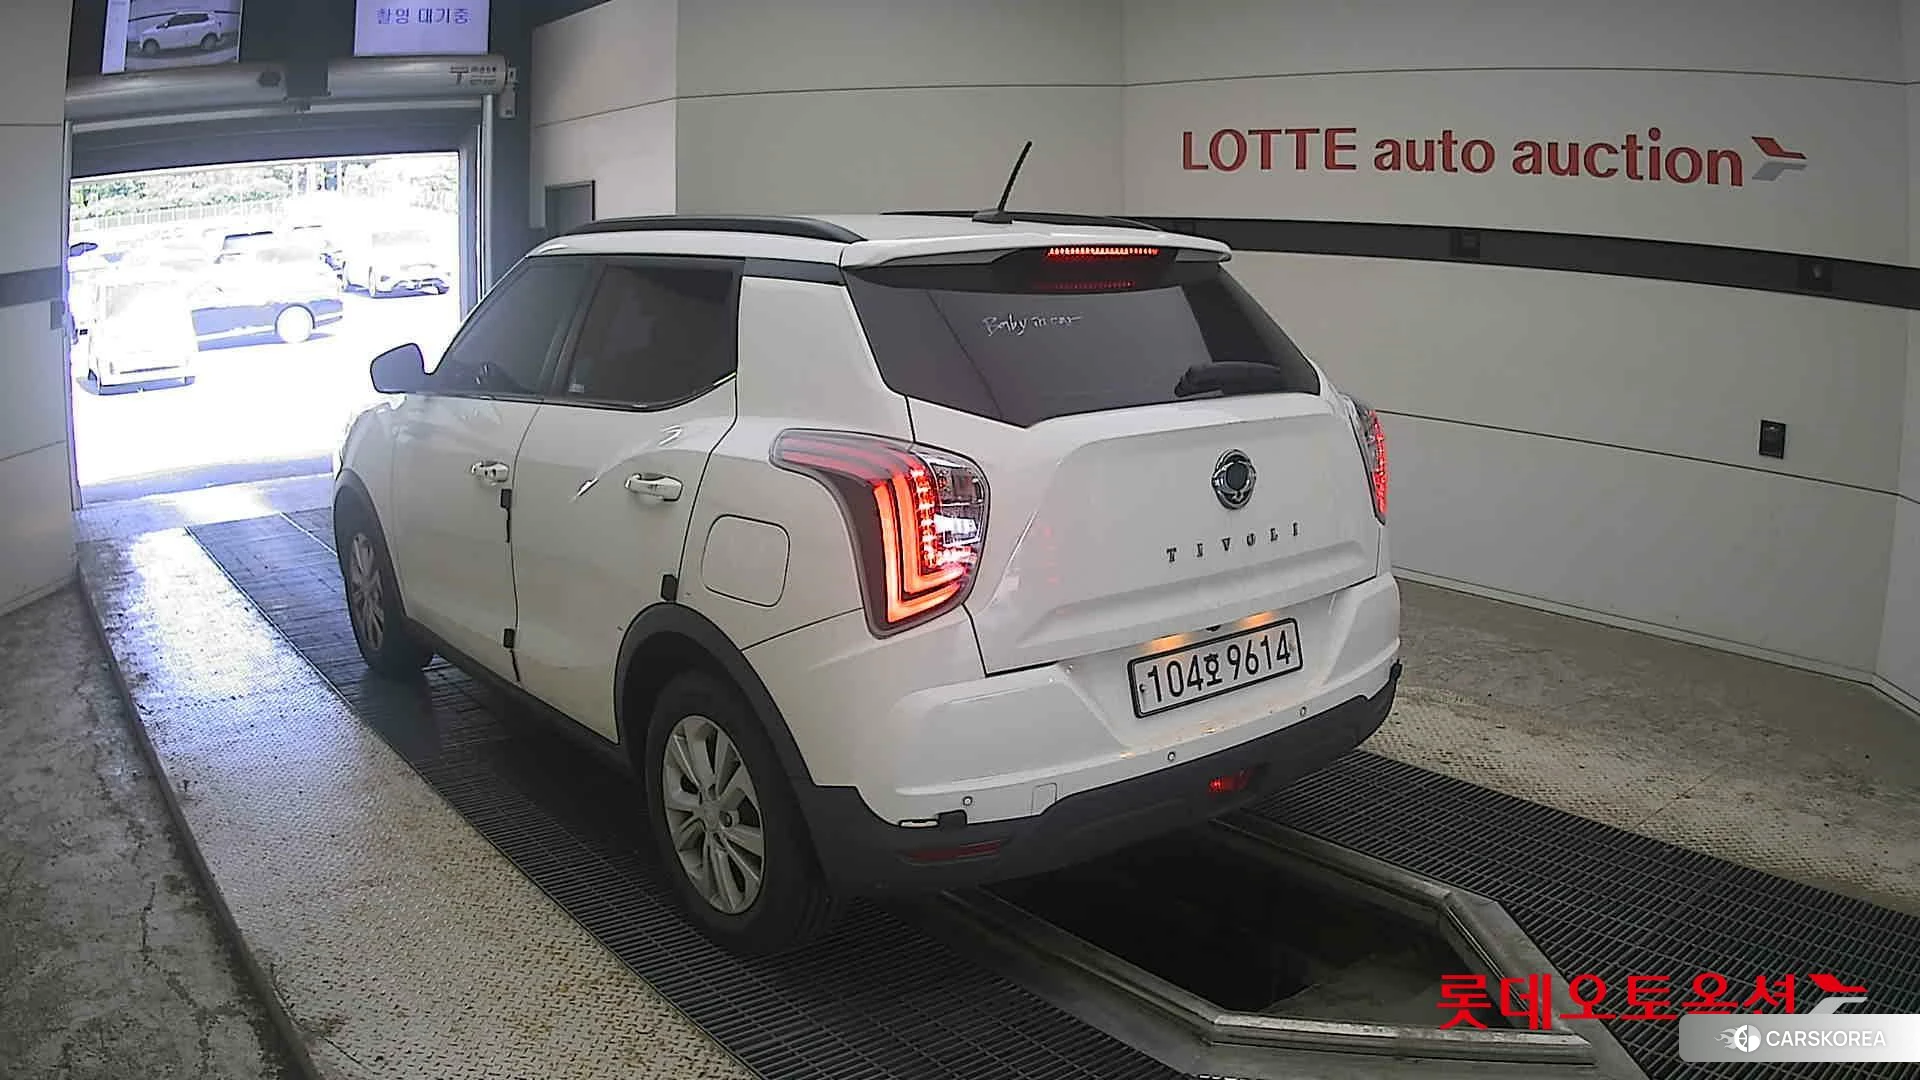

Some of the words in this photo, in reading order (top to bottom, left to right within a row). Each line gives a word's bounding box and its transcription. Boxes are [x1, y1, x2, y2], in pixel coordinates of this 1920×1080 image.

[418, 8, 470, 24] 대기중
[1182, 127, 1357, 171] LOTTE
[1374, 130, 1496, 172] auto
[1512, 127, 1744, 187] auction
[1227, 629, 1291, 680] 9614
